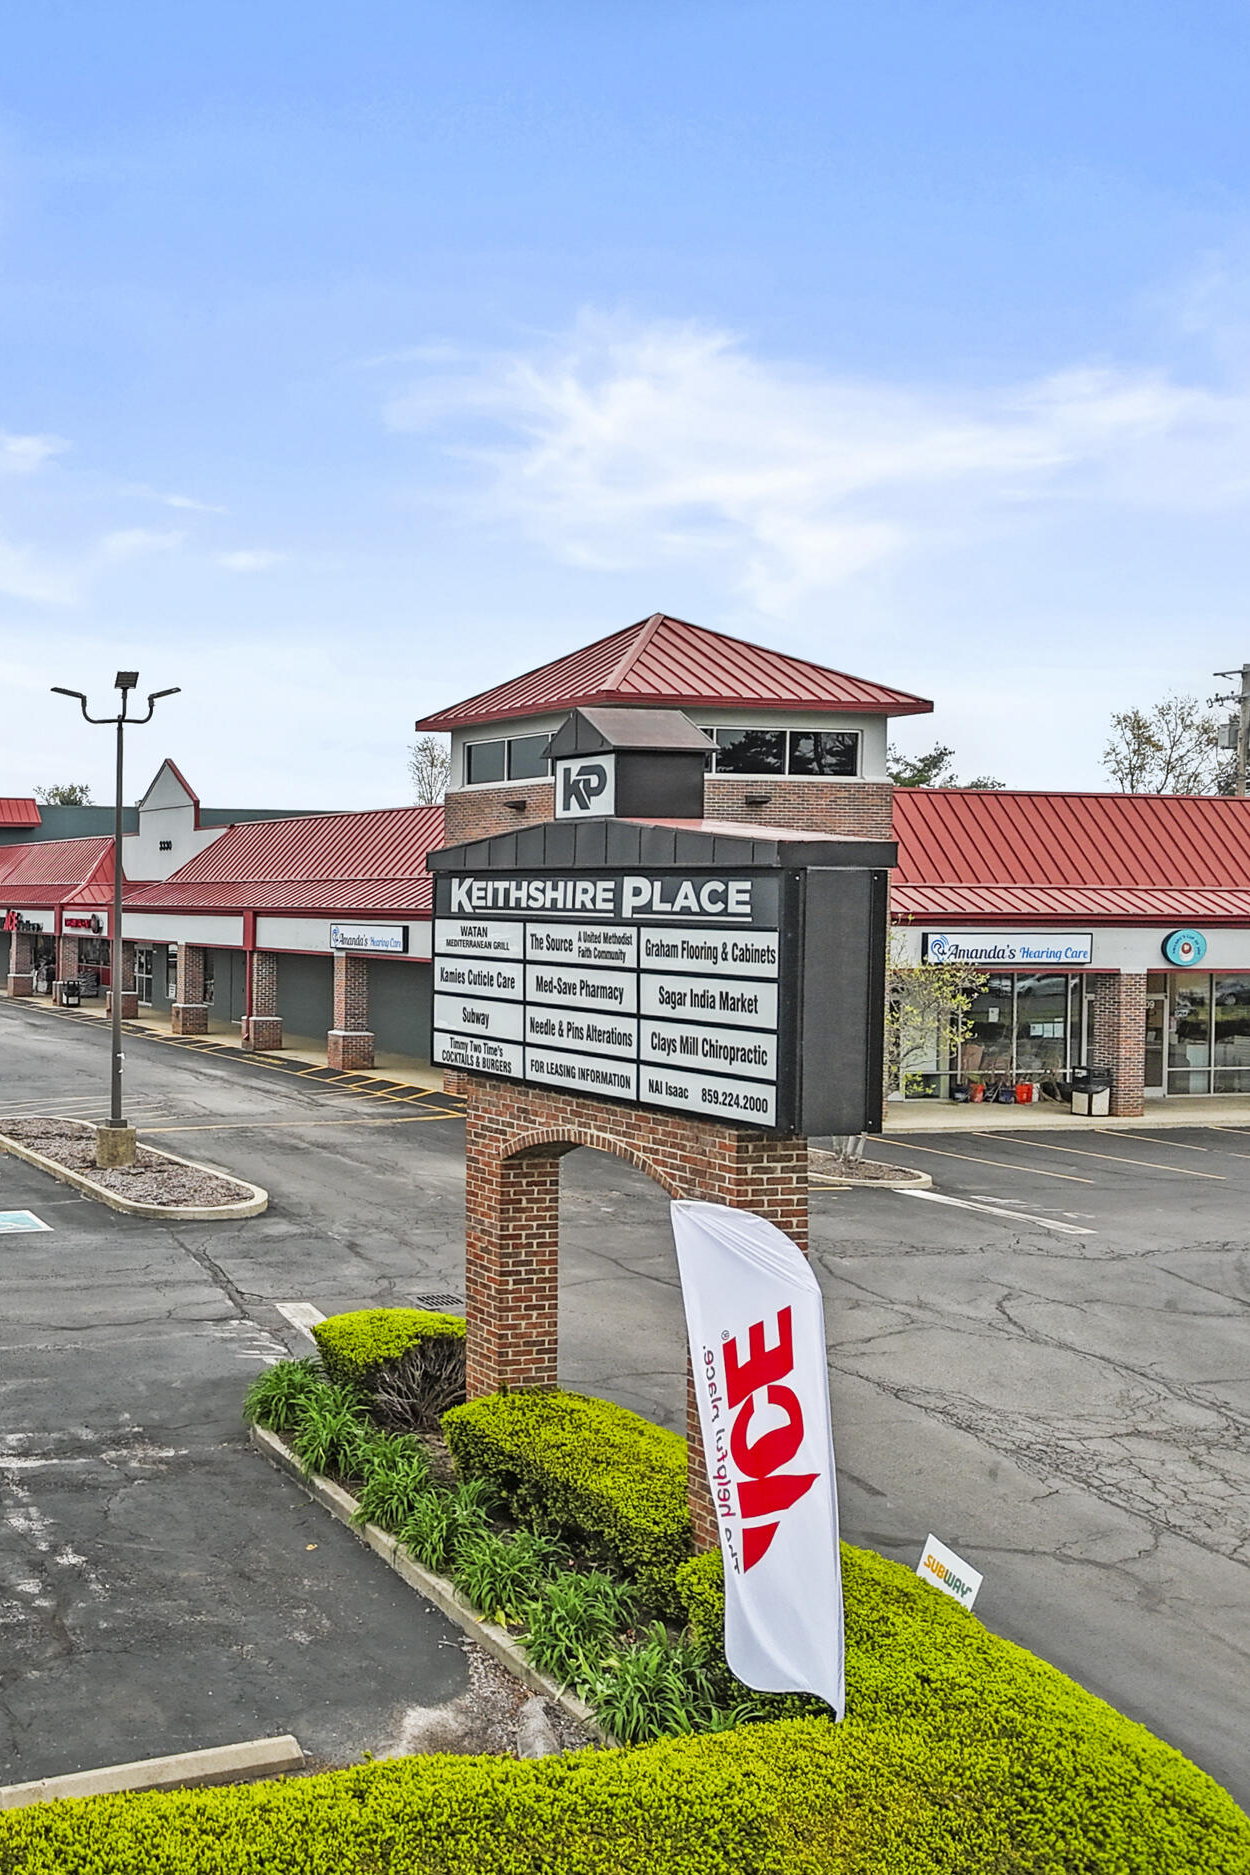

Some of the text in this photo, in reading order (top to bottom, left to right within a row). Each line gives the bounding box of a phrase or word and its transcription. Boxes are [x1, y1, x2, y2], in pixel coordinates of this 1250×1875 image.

[563, 764, 607, 811] KP
[622, 876, 752, 918] PLACE
[338, 933, 368, 947] Amanda's
[460, 925, 488, 938] WATAN
[530, 933, 574, 953] The Source
[577, 931, 633, 946] A United Methodist
[445, 938, 510, 951] MEDITERRANEAN GRILL
[577, 946, 626, 964] Faith Community
[645, 938, 776, 965] Graham Flooring & Cabinets
[947, 944, 1089, 962] Amanda's Hearing Care
[440, 967, 515, 989] Kamies Cuticle Care
[535, 975, 624, 1005] Med-Save Pharmacy
[658, 985, 759, 1014] Sagar India Market
[462, 1006, 489, 1030] Subway
[530, 1016, 633, 1048] Needle & Pins Alterations
[449, 1037, 503, 1058] Timmy Two Time's
[650, 1031, 768, 1066] Clays Mill Chiropractic
[441, 1050, 512, 1074] COCKTAILS & BURGERS
[530, 1059, 631, 1089] FOR LEASING INFORMATION
[648, 1079, 769, 1113] NAI Isaac 859.224.2000
[923, 1554, 972, 1598] SUBWAY
